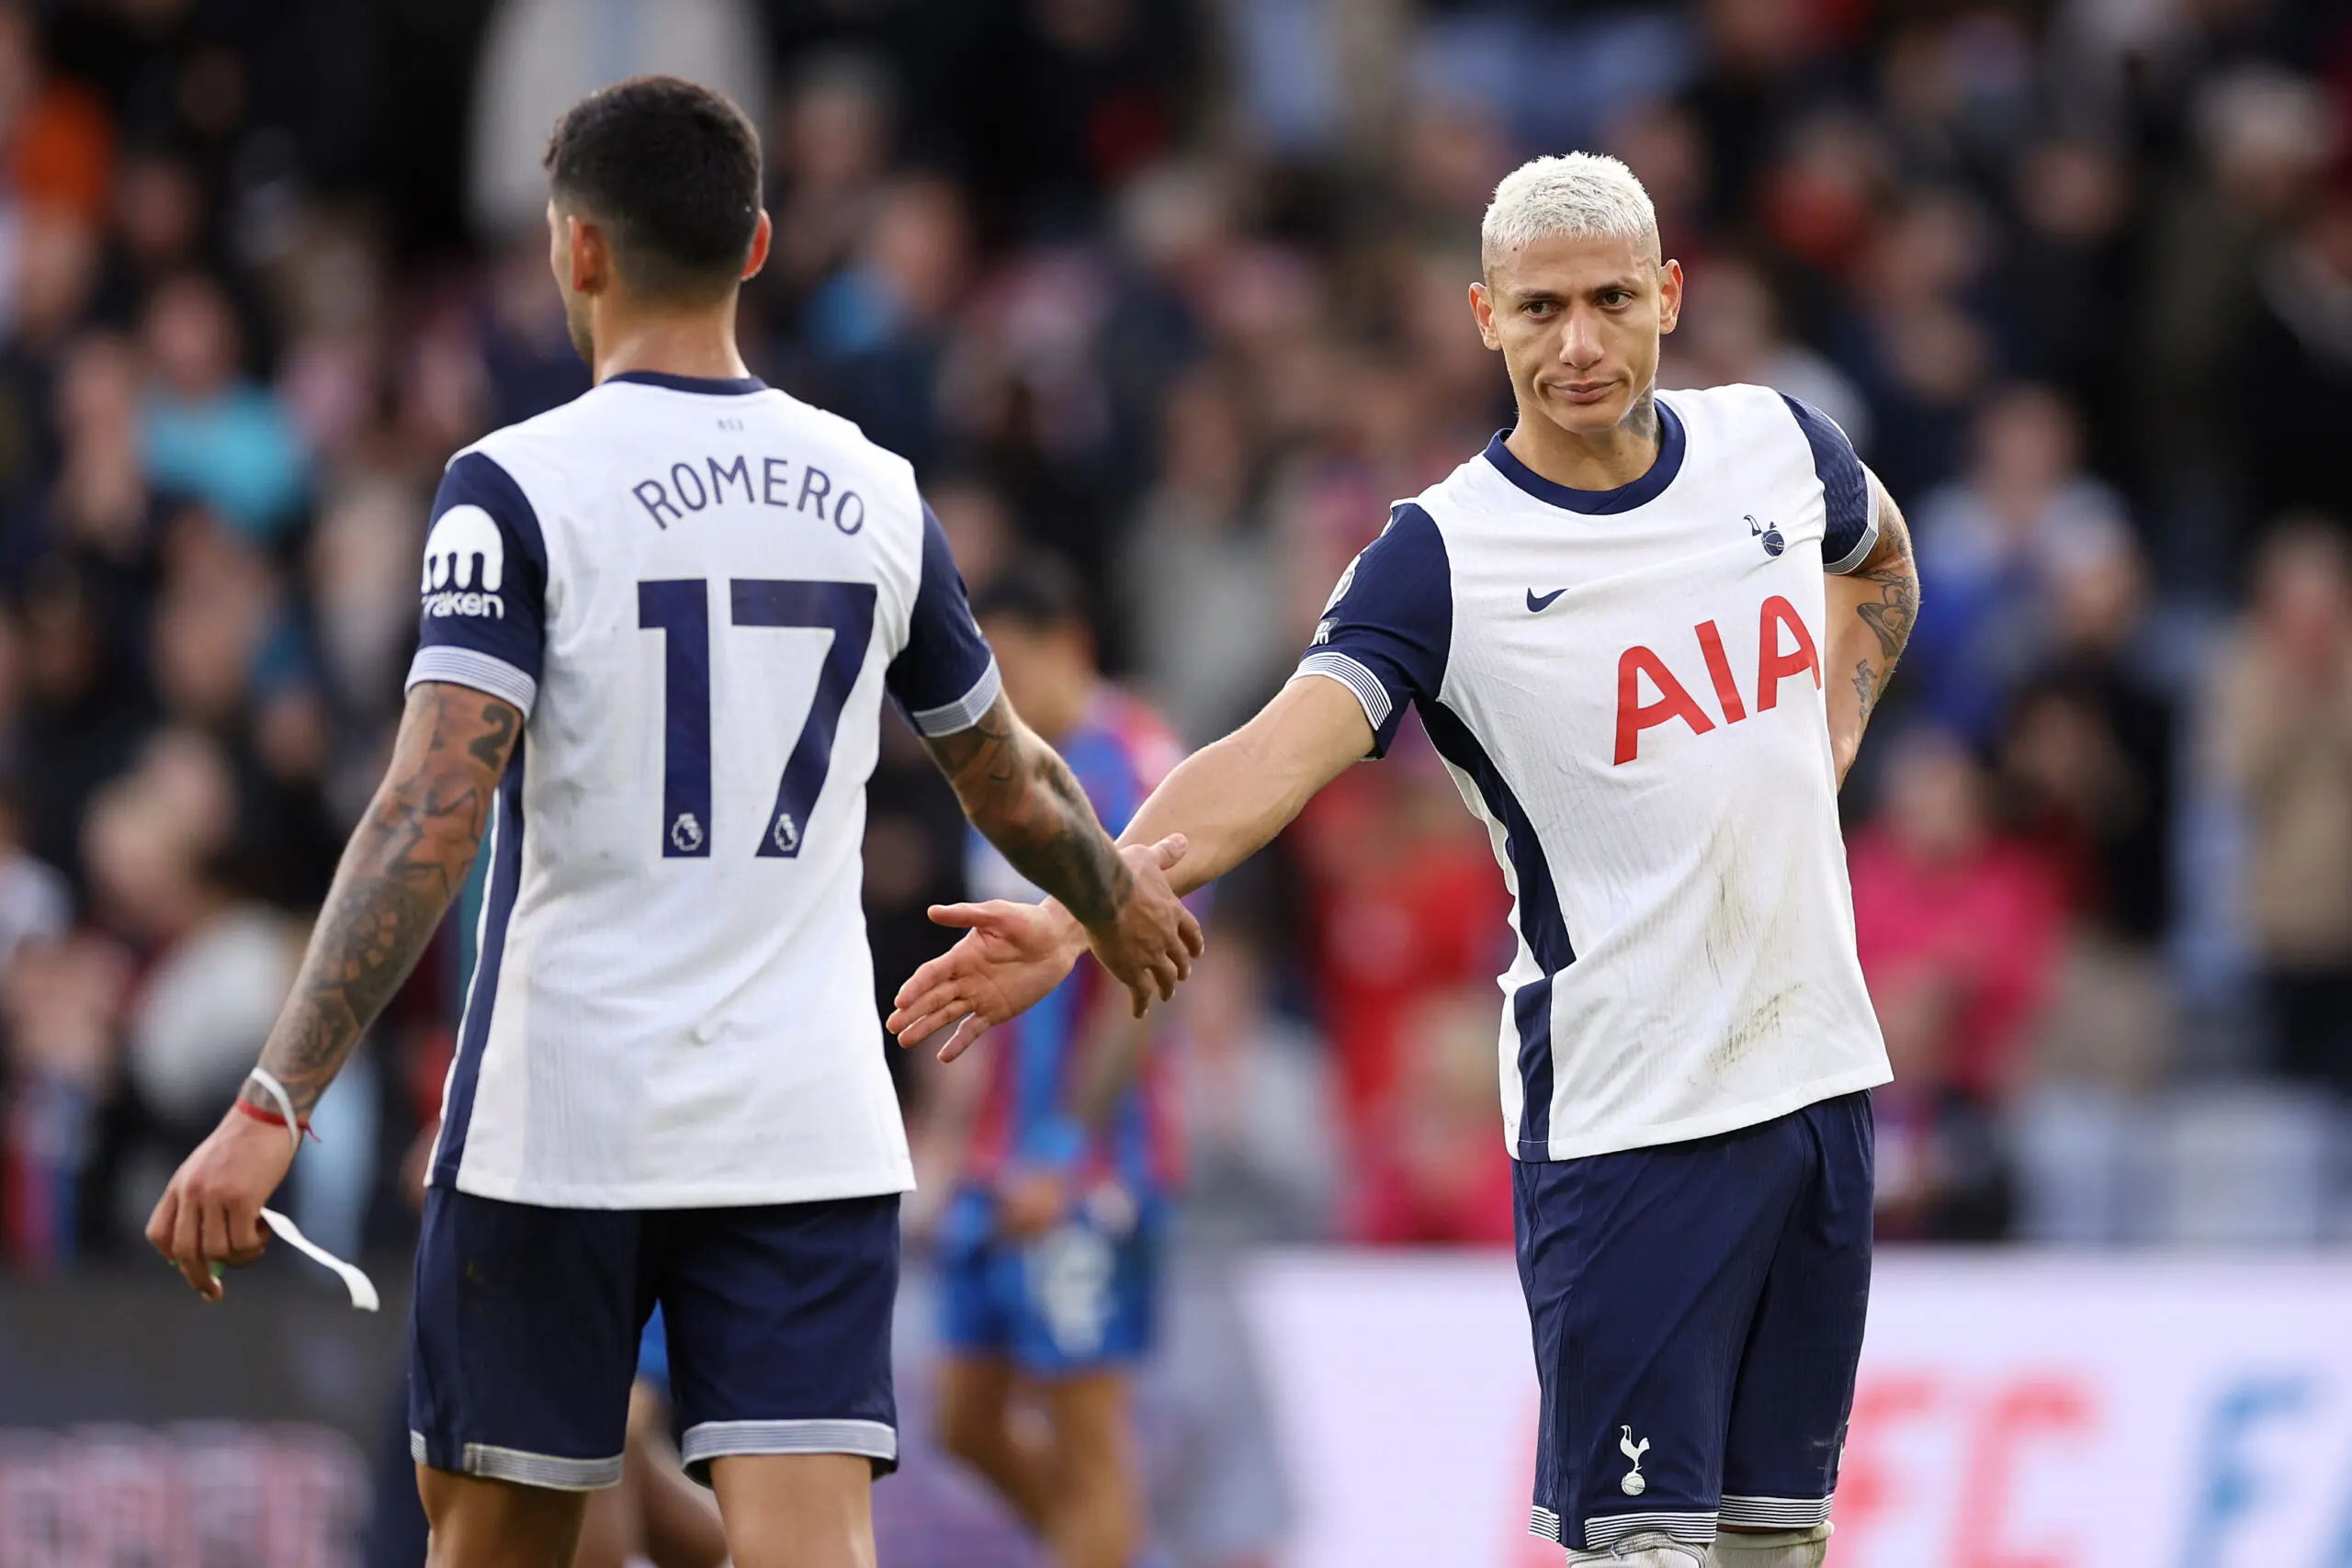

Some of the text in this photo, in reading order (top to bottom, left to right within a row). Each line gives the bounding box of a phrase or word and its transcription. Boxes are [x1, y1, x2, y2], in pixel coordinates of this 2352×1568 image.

[631, 455, 865, 537] ROMERO
[421, 591, 505, 620] raken
[637, 578, 878, 860] 17
[1614, 594, 1821, 765] AIA
